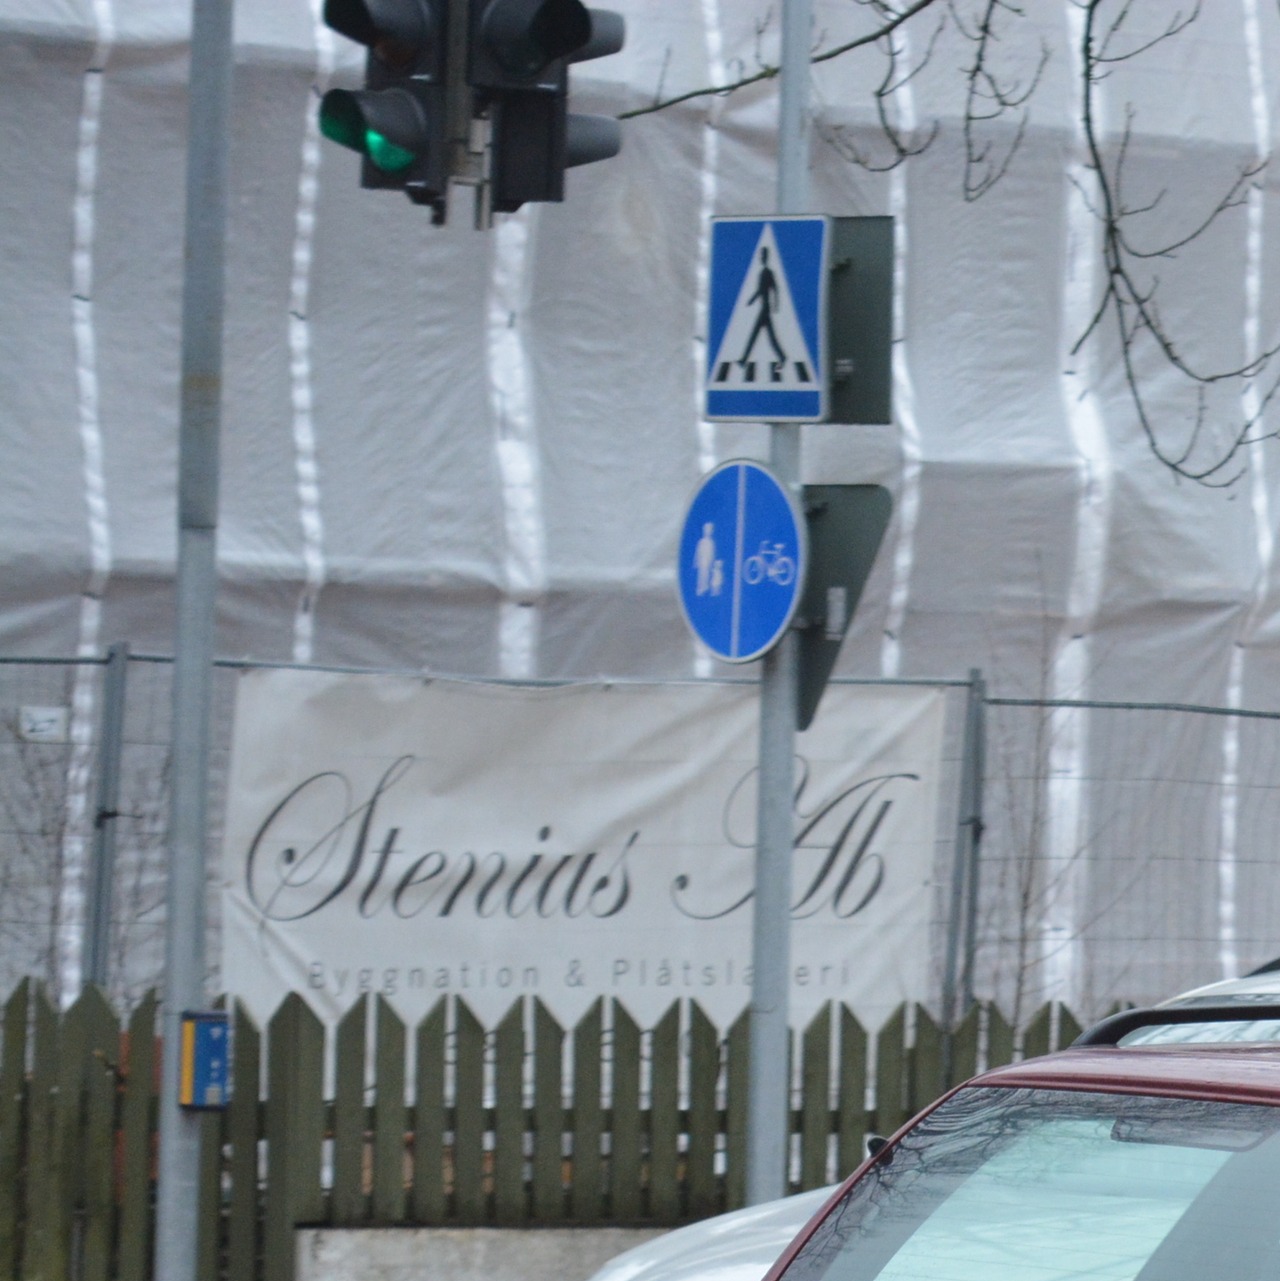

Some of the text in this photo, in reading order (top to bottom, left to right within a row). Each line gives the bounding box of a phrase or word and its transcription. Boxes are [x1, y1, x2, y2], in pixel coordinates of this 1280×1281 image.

[306, 957, 849, 996] Byggnation & Plåtslaeri
